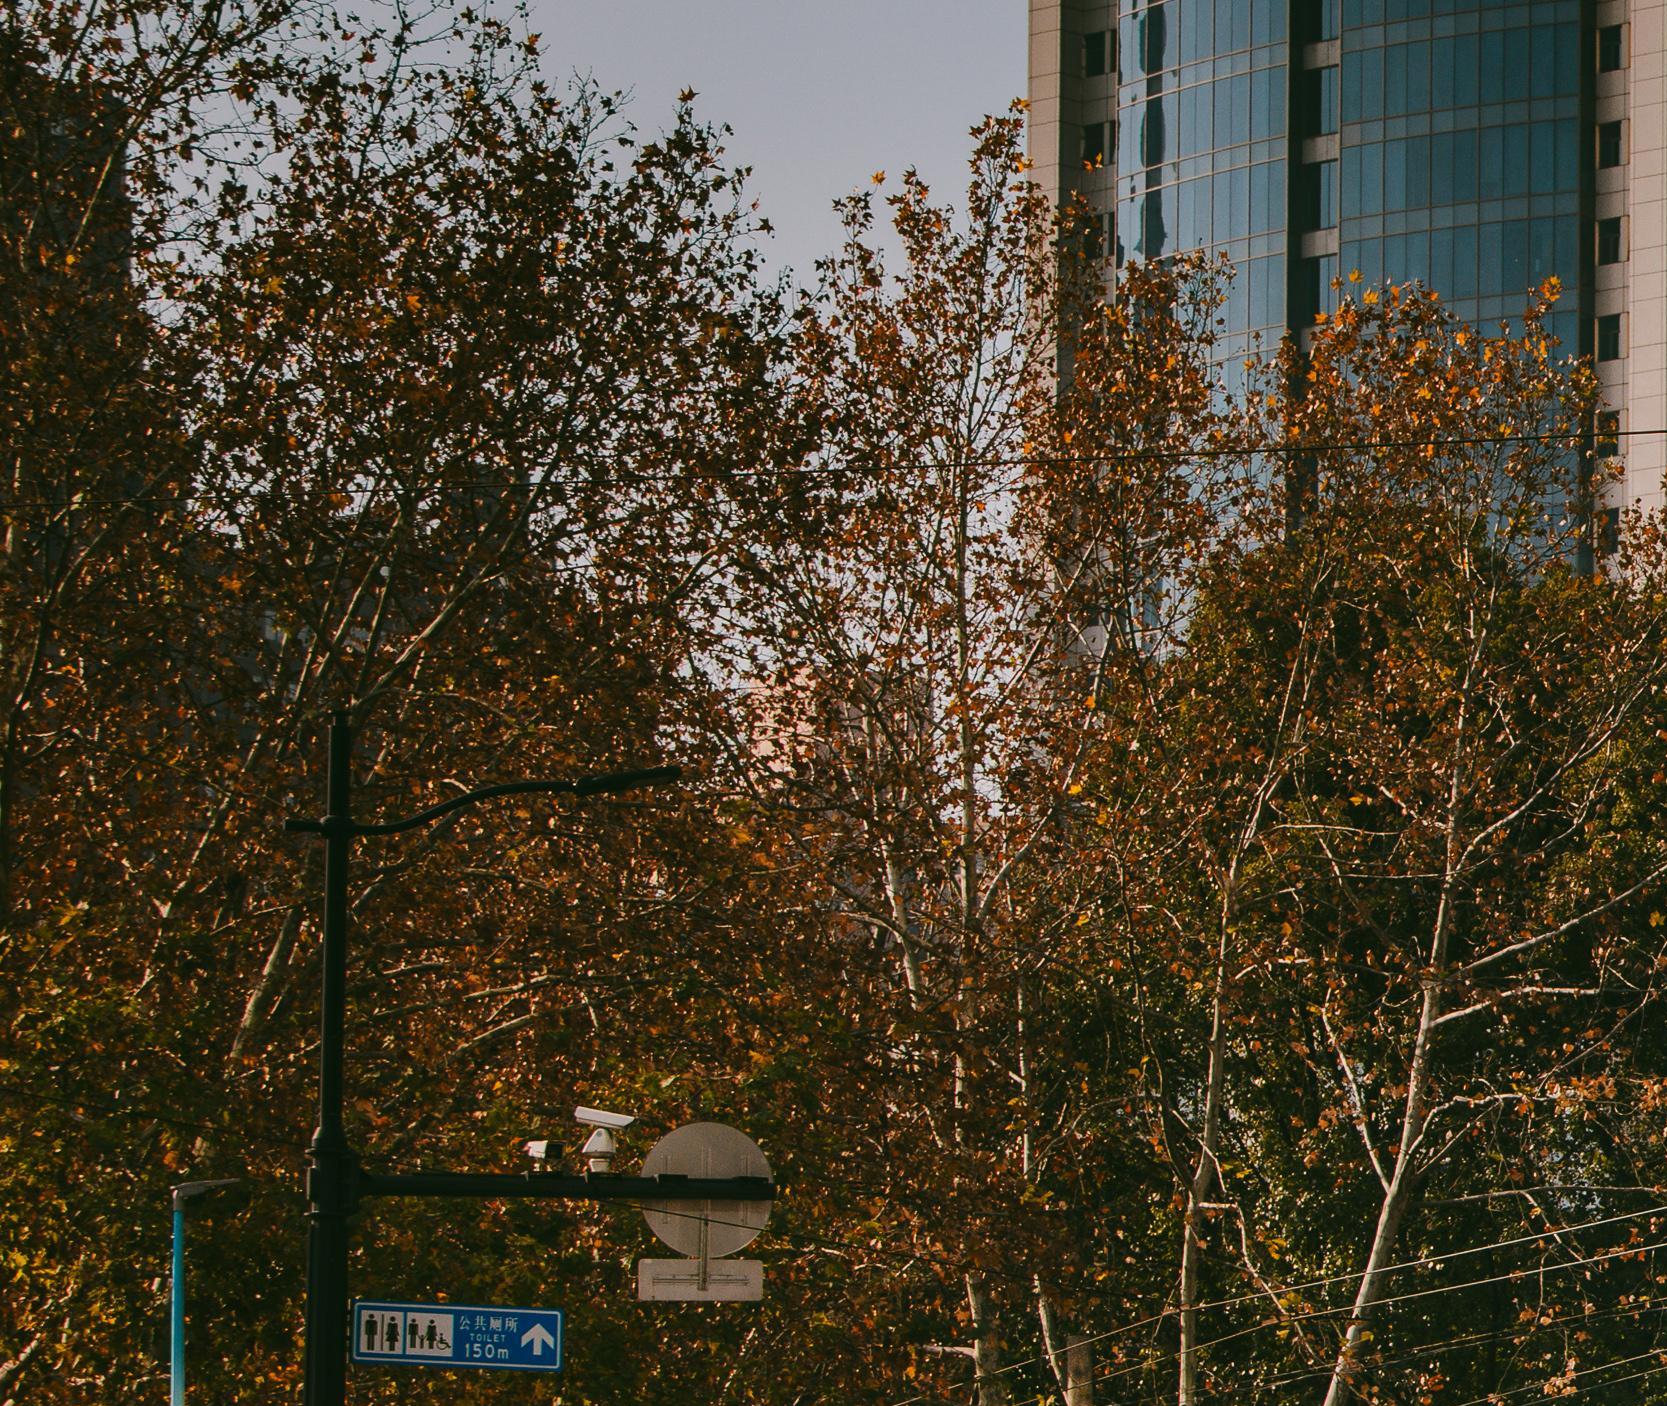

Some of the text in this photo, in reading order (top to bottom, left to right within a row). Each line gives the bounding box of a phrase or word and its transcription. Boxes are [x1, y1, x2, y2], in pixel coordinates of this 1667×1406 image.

[459, 1315, 519, 1333] 公共厕所
[469, 1333, 506, 1343] TOILET
[465, 1343, 509, 1359] 150m
